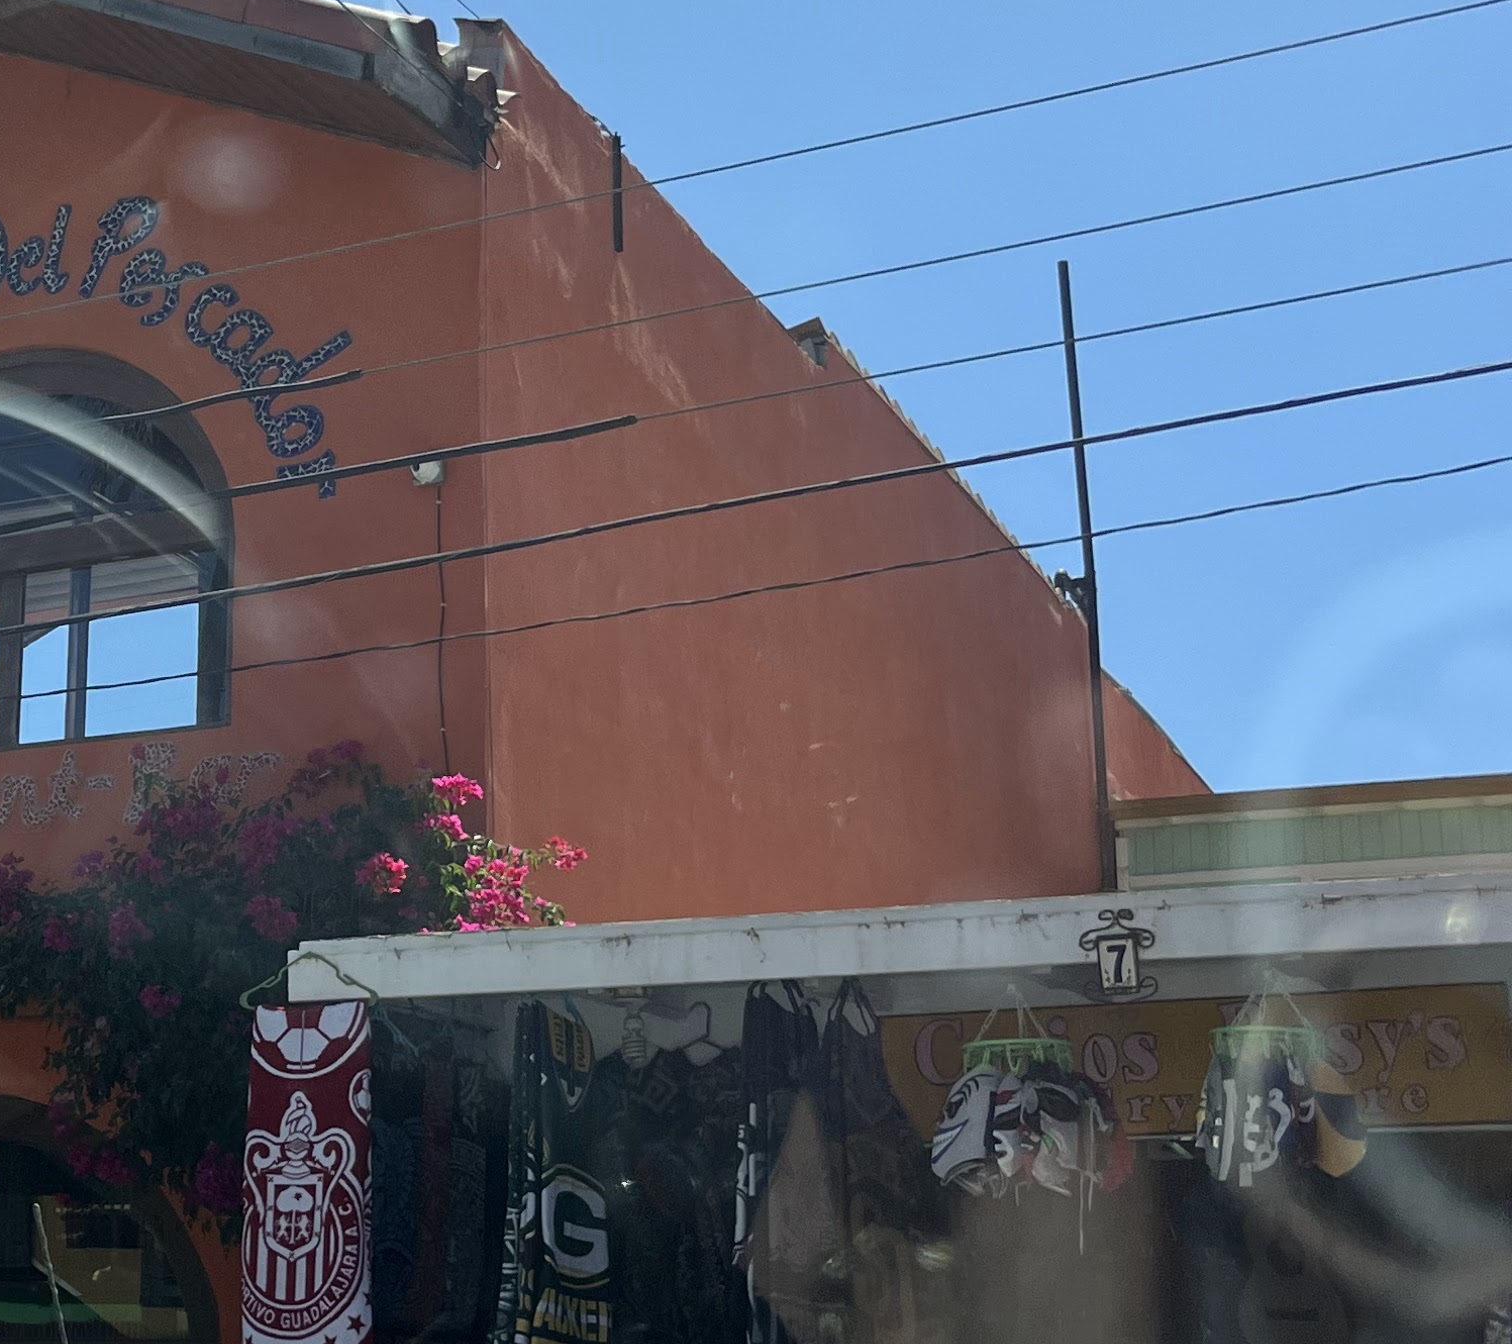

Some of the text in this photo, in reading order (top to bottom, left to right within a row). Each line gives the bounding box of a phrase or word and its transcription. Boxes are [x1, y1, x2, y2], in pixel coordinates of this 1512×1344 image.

[78, 196, 353, 500] Pescador
[1106, 944, 1127, 984] 7
[541, 1174, 610, 1275] G
[280, 1244, 359, 1329] GUADALAJARA
